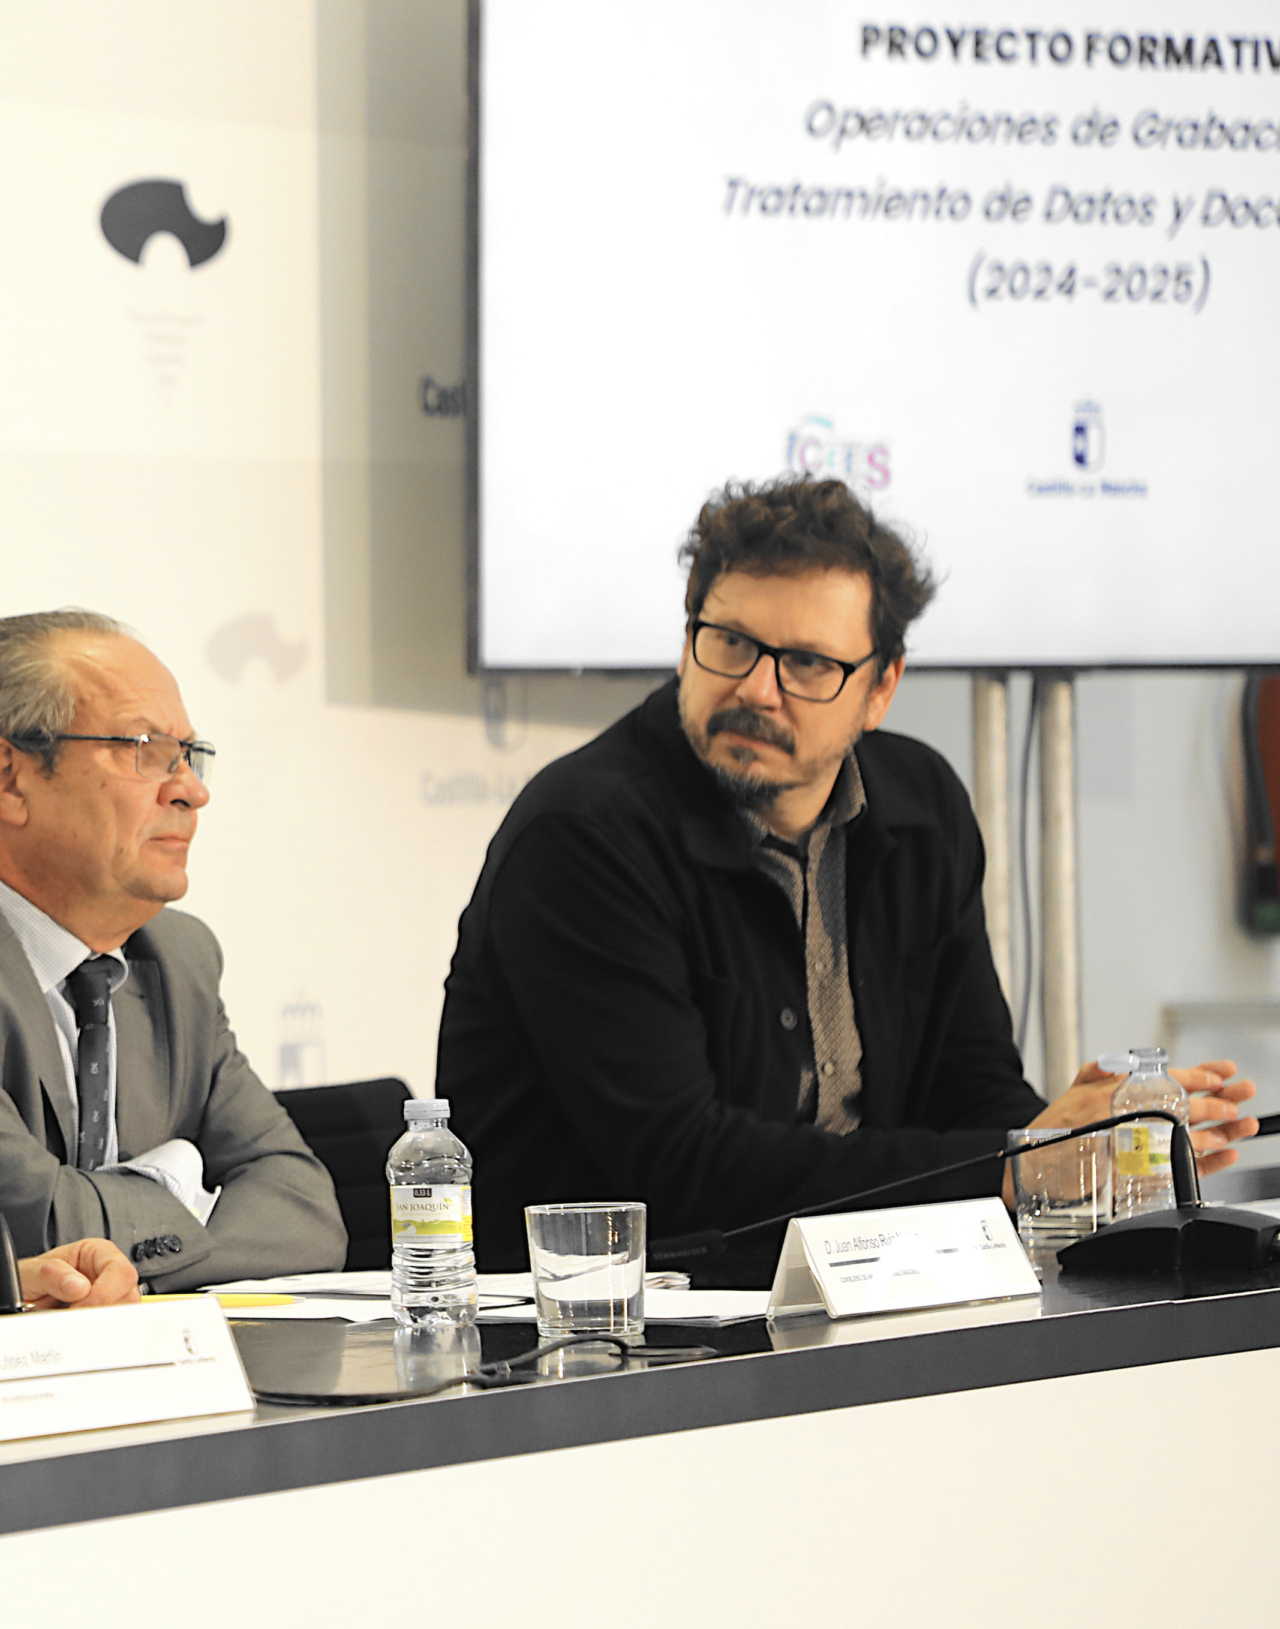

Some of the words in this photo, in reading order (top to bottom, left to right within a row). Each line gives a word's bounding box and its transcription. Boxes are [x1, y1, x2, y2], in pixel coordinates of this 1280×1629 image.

[860, 25, 1074, 64] PROYECTO
[806, 97, 1060, 152] Operaciones
[1071, 104, 1120, 146] de
[724, 175, 973, 219] Tratamiento
[983, 180, 1033, 222] de
[1044, 184, 1156, 226] Datos
[1166, 195, 1196, 241] y
[1202, 187, 1280, 229] Doc
[968, 249, 1211, 312] (2024-2025)
[396, 1203, 409, 1211] SAN
[835, 1239, 853, 1254] Juan
[853, 1236, 880, 1251] Alfonso
